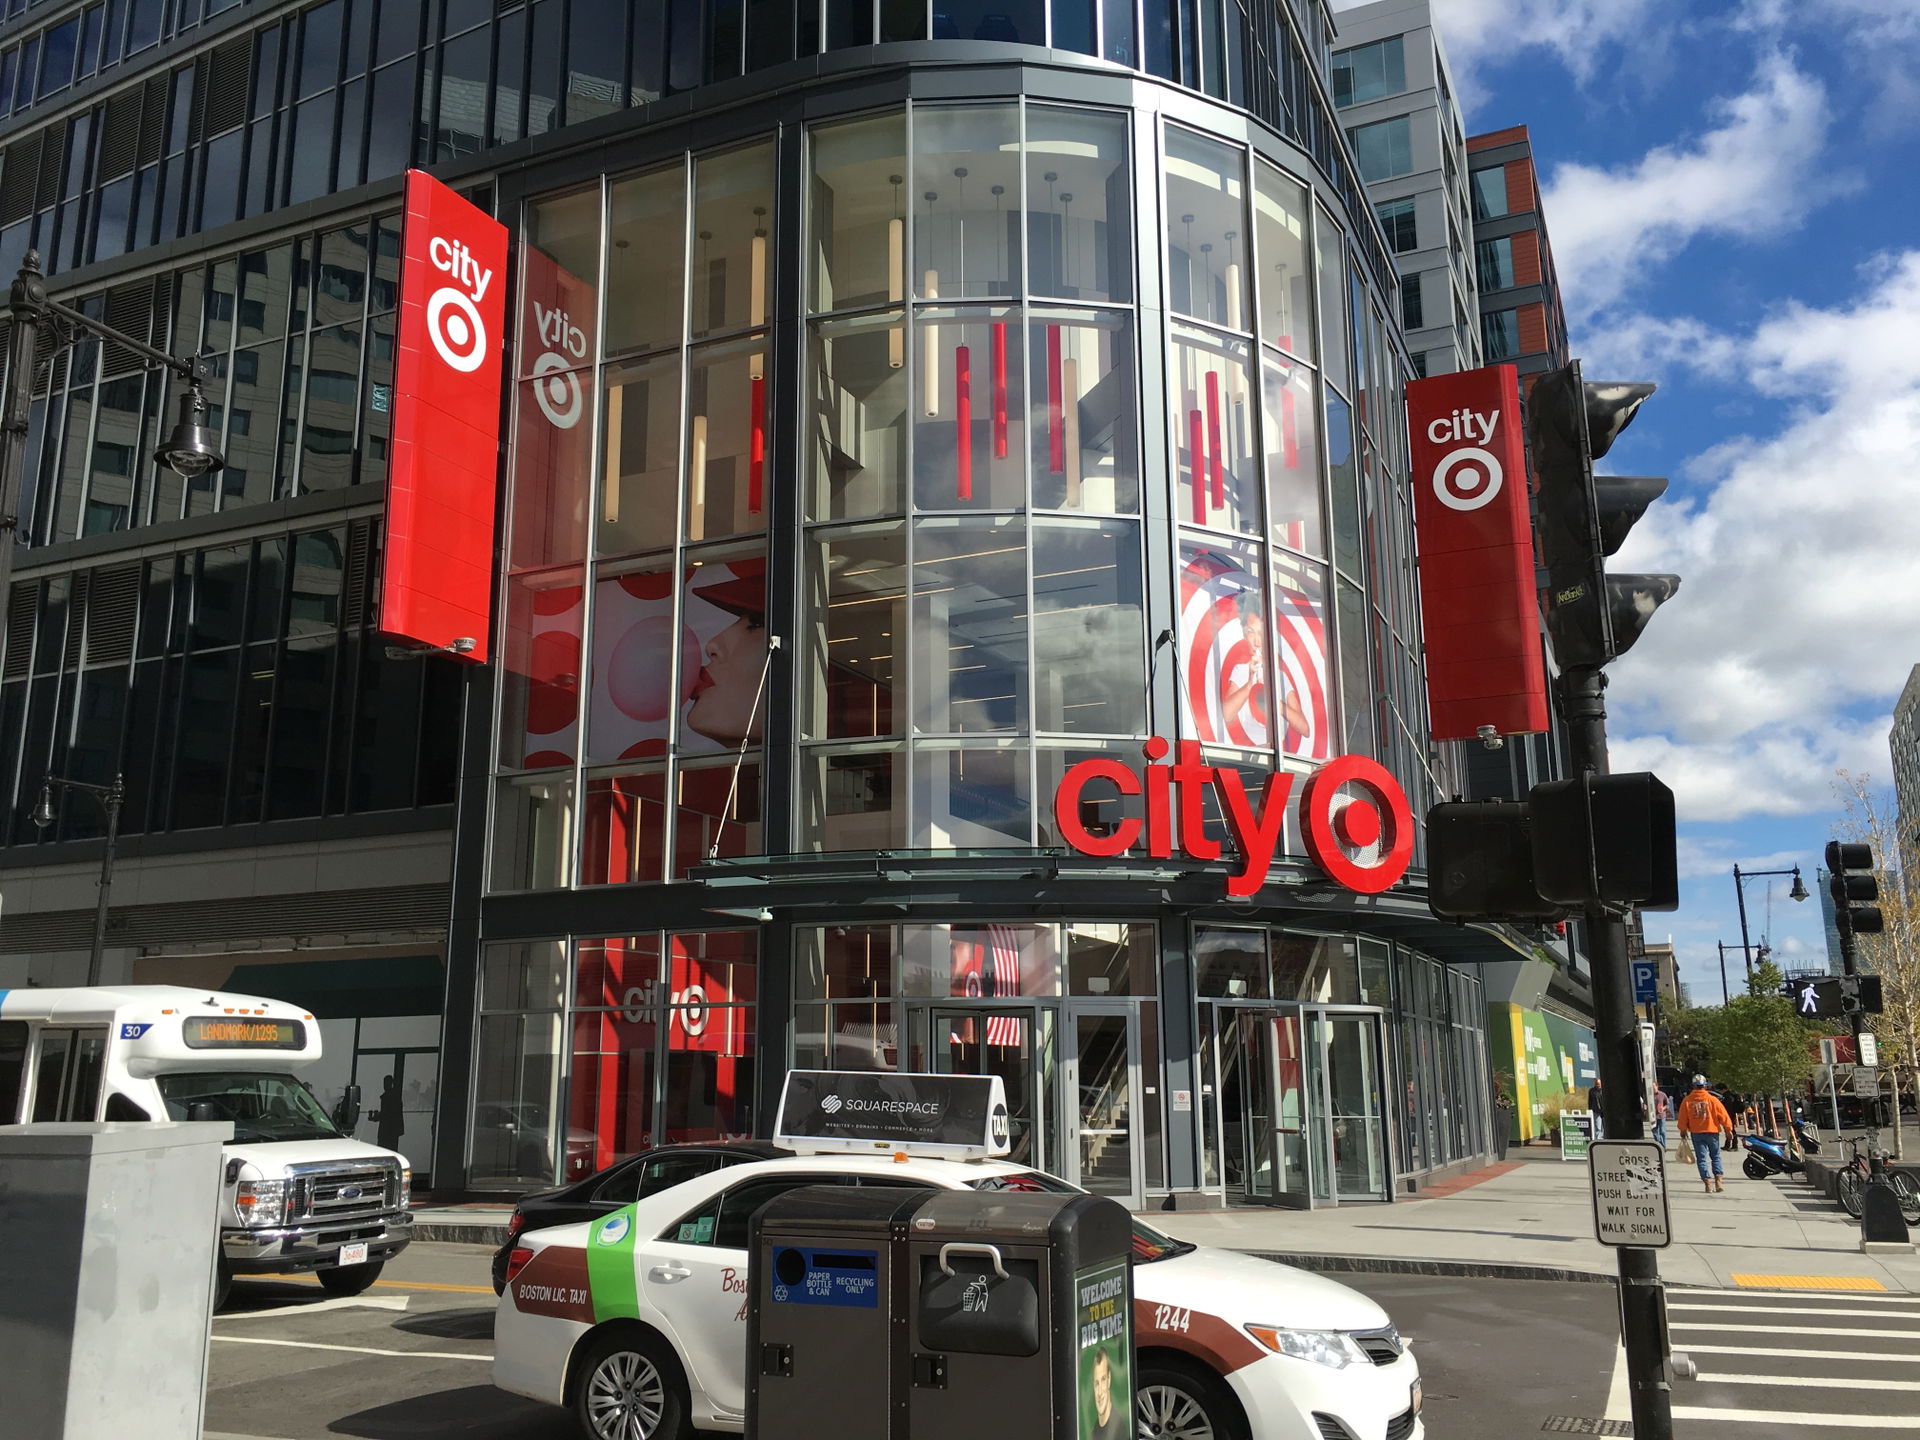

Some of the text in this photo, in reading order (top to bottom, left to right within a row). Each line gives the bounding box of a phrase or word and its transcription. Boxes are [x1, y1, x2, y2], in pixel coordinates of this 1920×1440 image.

[429, 236, 493, 303] city
[1427, 408, 1500, 446] city
[1055, 735, 1295, 897] city
[1636, 967, 1652, 987] P
[124, 1025, 142, 1038] 30
[200, 1023, 278, 1042] LANDMARK/1295
[845, 1099, 940, 1115] SQUARESPACE
[884, 1125, 913, 1133] COMMERCE
[992, 1114, 1008, 1137] TAXI
[1618, 1155, 1650, 1166] CROSS
[1597, 1172, 1630, 1183] STREE
[1597, 1188, 1622, 1199] PUSH
[1606, 1205, 1656, 1217] WAIT FOR
[1600, 1222, 1665, 1235] WALK SIGNAL
[808, 1271, 831, 1282] PAPER
[836, 1276, 875, 1288] RECYCLING
[806, 1279, 833, 1289] BOTTLE
[808, 1286, 830, 1296] & CAN
[845, 1284, 865, 1295] ONLY
[1080, 1275, 1122, 1307] WELCOME
[519, 1284, 587, 1305] BOSTON LIC. TAXI
[1089, 1299, 1115, 1322] TO THE
[1155, 1305, 1191, 1333] 1244
[1081, 1312, 1123, 1349] BIG TIME
